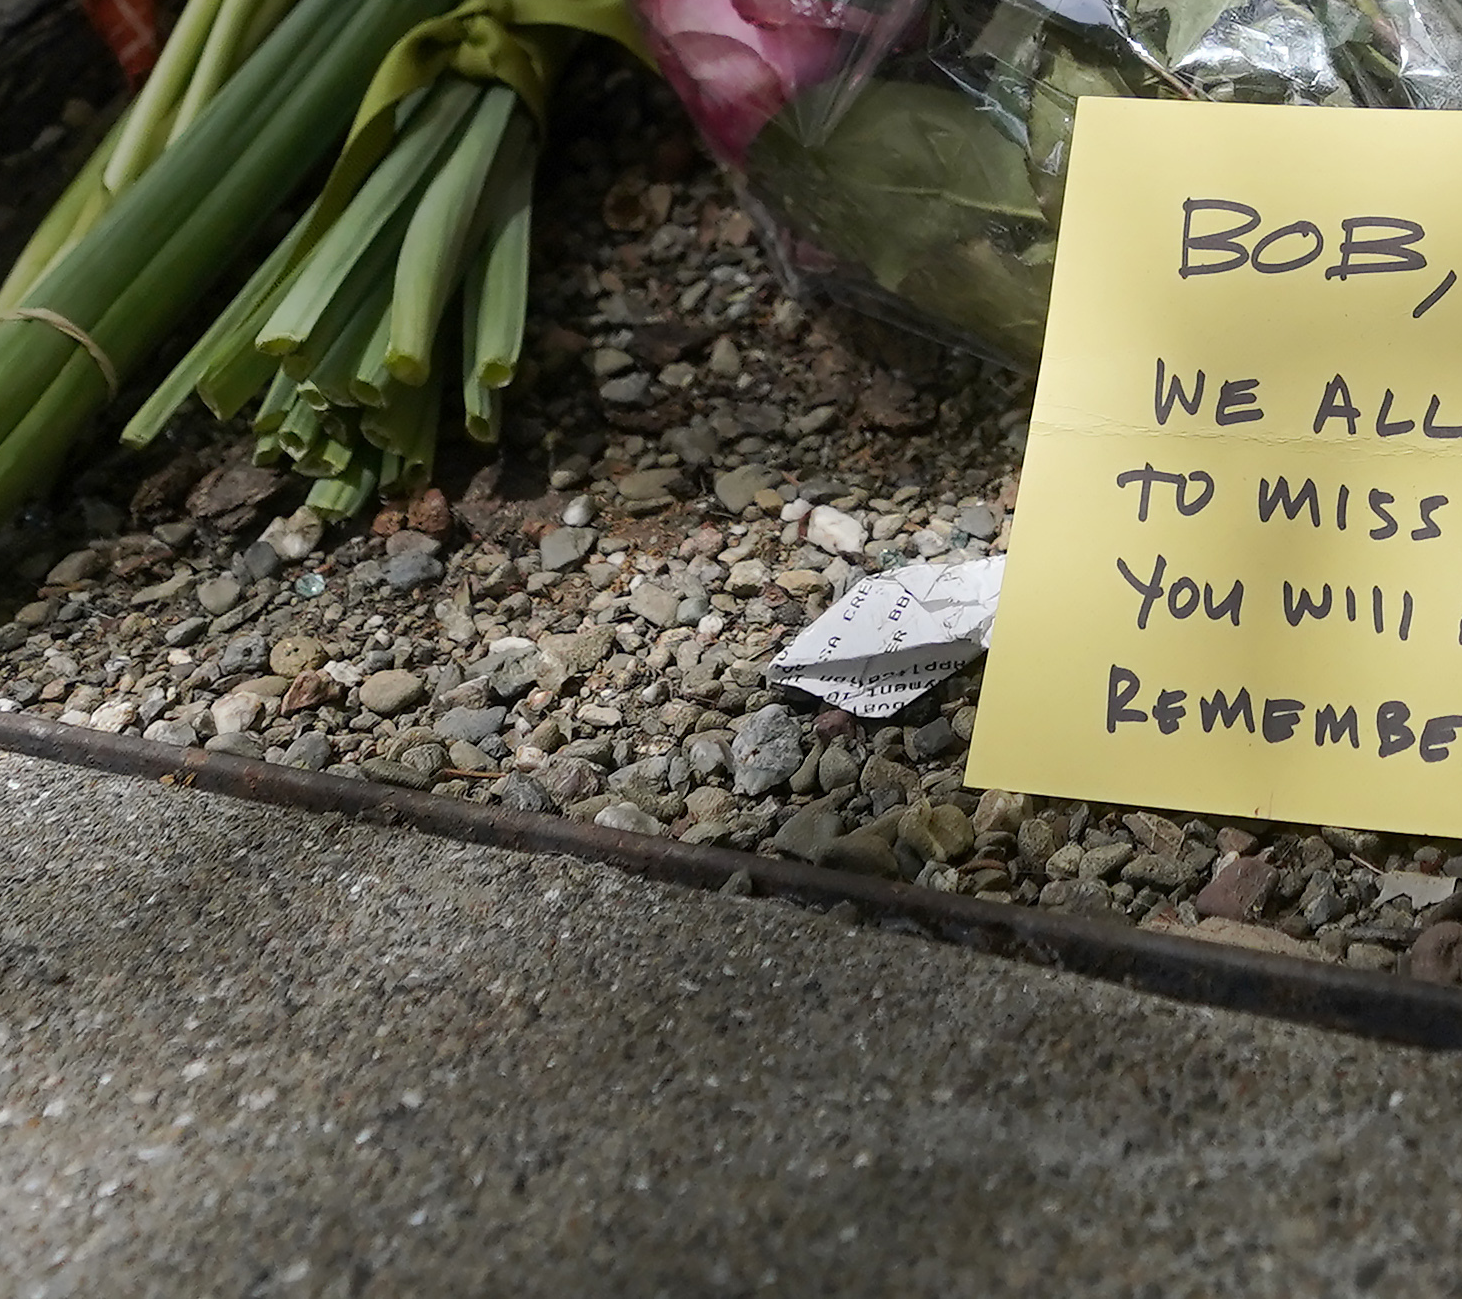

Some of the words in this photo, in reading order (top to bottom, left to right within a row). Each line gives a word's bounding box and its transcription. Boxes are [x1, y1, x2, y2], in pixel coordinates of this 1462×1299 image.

[1177, 196, 1459, 320] BOB,
[1153, 356, 1266, 428] WE
[1115, 461, 1216, 523] TO
[1257, 474, 1450, 542] MISS
[1115, 553, 1246, 631] YOU
